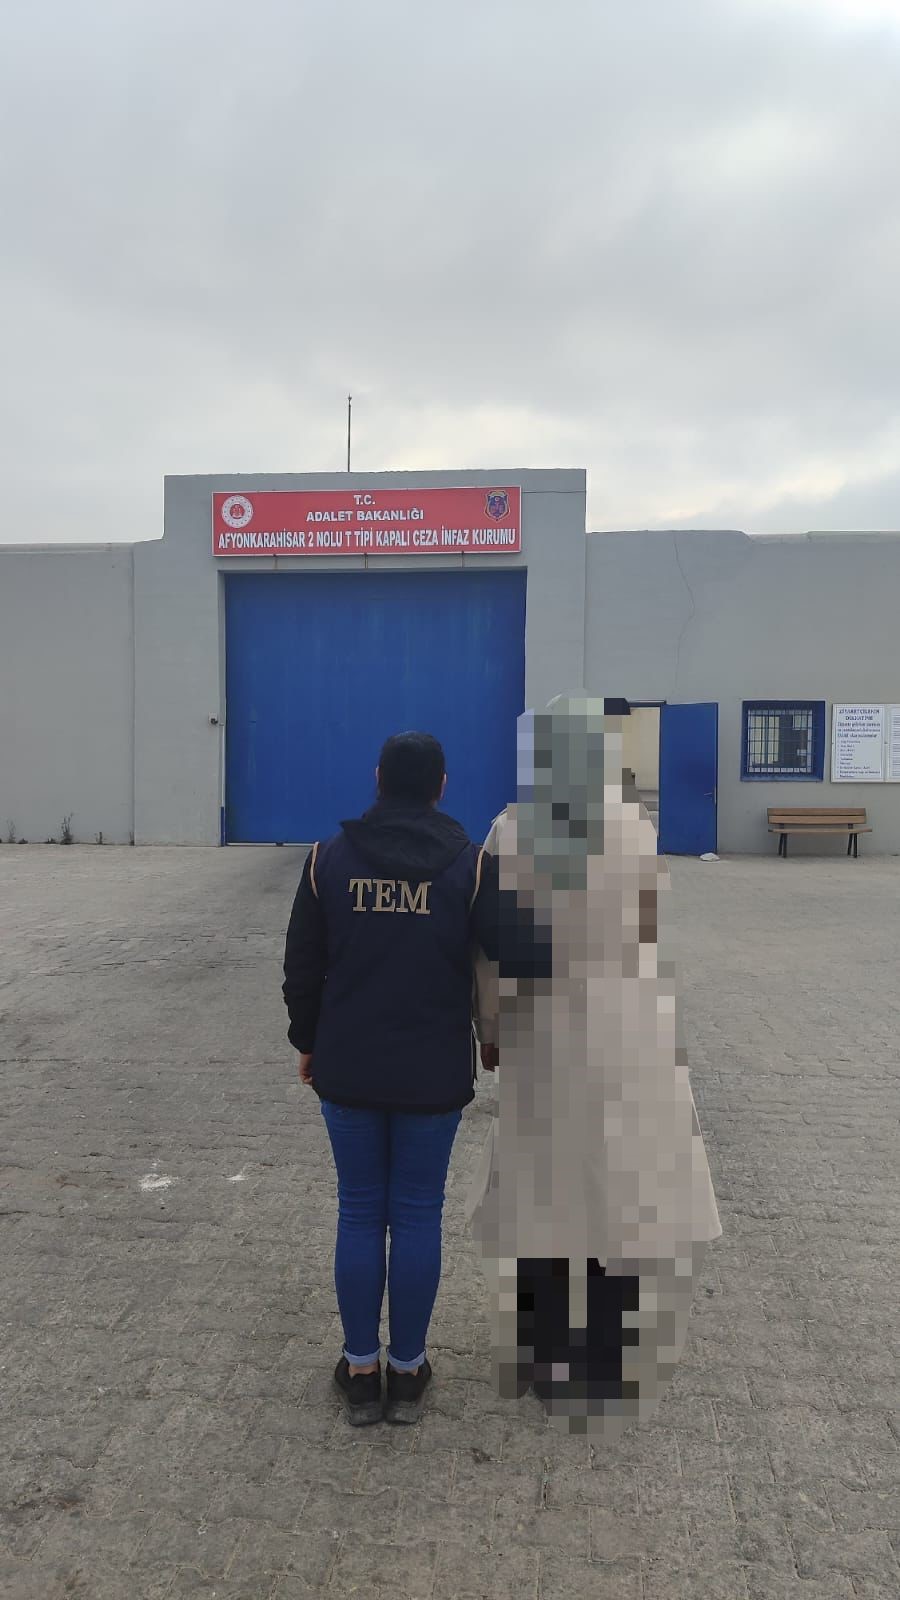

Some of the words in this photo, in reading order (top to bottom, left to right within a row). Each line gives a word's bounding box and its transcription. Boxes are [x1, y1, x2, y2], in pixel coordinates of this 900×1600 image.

[354, 494, 376, 505] T.C.
[306, 511, 353, 522] ADALET
[356, 507, 424, 521] BAKANLIĞI
[218, 528, 306, 549] AFYONKARAHİSAR
[308, 531, 314, 547] 2
[316, 531, 343, 547] NOLU
[345, 531, 352, 547] T
[354, 527, 373, 547] TİPİ
[376, 530, 410, 547] KAPALI
[413, 529, 439, 546] CEZA
[441, 525, 470, 546] İNFAZ
[472, 528, 516, 545] KURUMU
[348, 878, 432, 914] TEM
